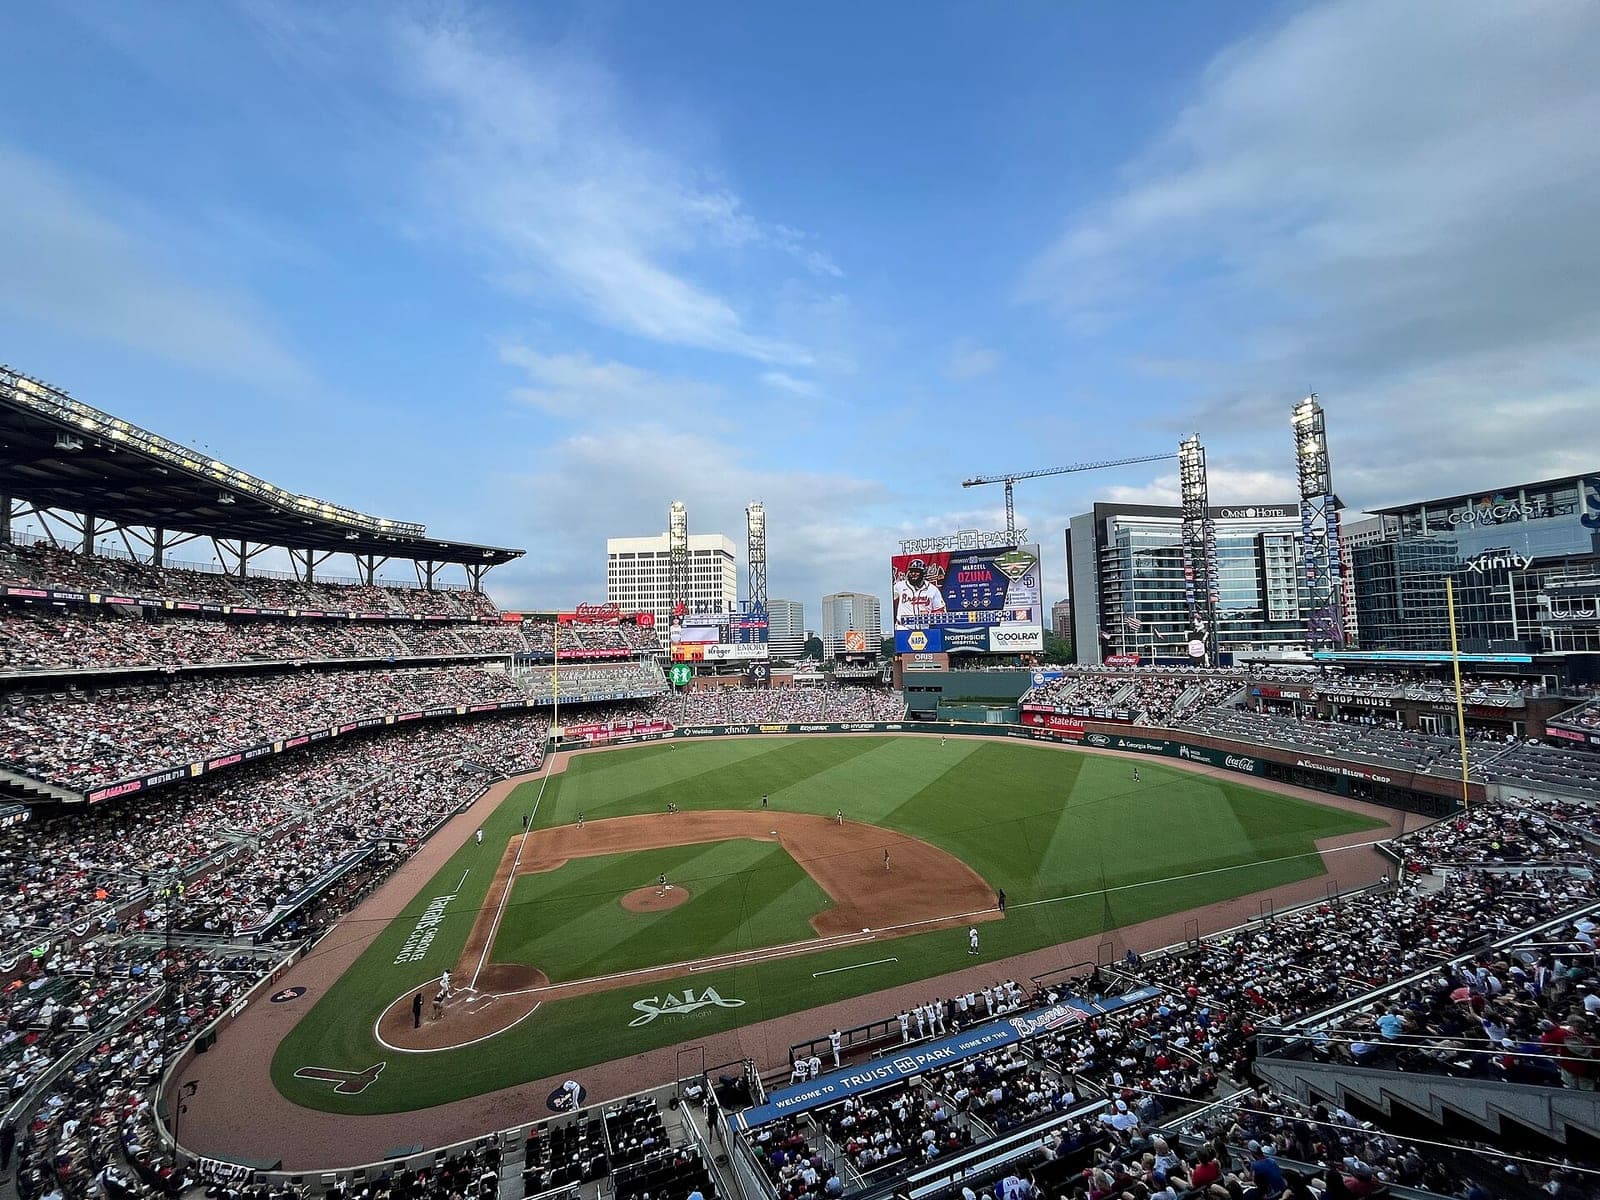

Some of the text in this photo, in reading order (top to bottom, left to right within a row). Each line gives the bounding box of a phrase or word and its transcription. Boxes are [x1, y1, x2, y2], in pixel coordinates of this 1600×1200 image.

[1449, 500, 1543, 525] COMCAST
[899, 528, 1028, 553] TRUIST PARK
[1466, 555, 1534, 574] xfinity
[958, 570, 993, 583] OZUNA
[945, 634, 985, 642] NORTHSIDE
[997, 632, 1039, 641] COOLRAY
[1280, 691, 1301, 699] LIGHT
[1327, 694, 1391, 708] CHOP HOUSE
[725, 726, 750, 735] xfinity
[1126, 742, 1163, 751] Georgia Power
[393, 929, 424, 965] CASINOS
[628, 986, 747, 1027] SAIA
[1009, 1004, 1070, 1038] Braves
[776, 1031, 1008, 1109] WELCOME TO TRUIST PARK HOME OF THE
